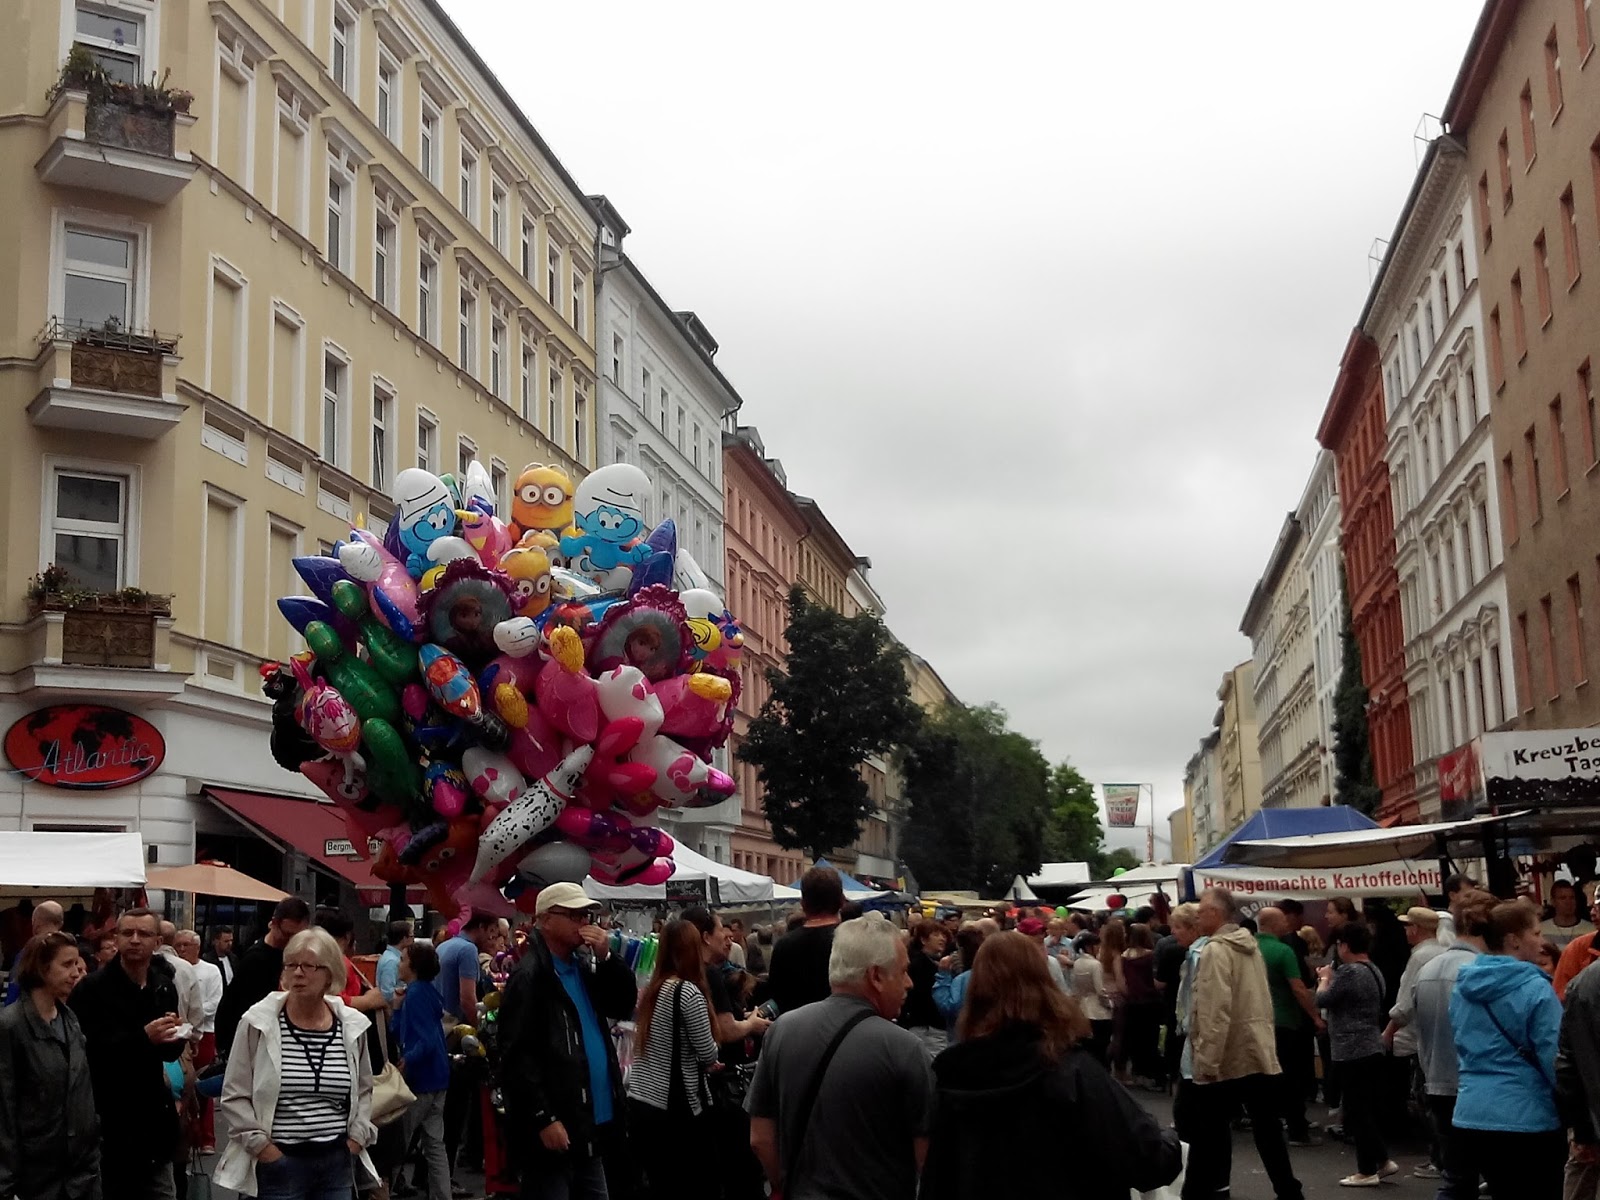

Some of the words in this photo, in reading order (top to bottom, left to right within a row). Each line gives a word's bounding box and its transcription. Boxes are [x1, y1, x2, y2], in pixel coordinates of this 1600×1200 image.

[9, 737, 156, 784] Atlantic
[1513, 736, 1600, 766] Kreuzbe
[1203, 875, 1327, 894] Hausgemachte
